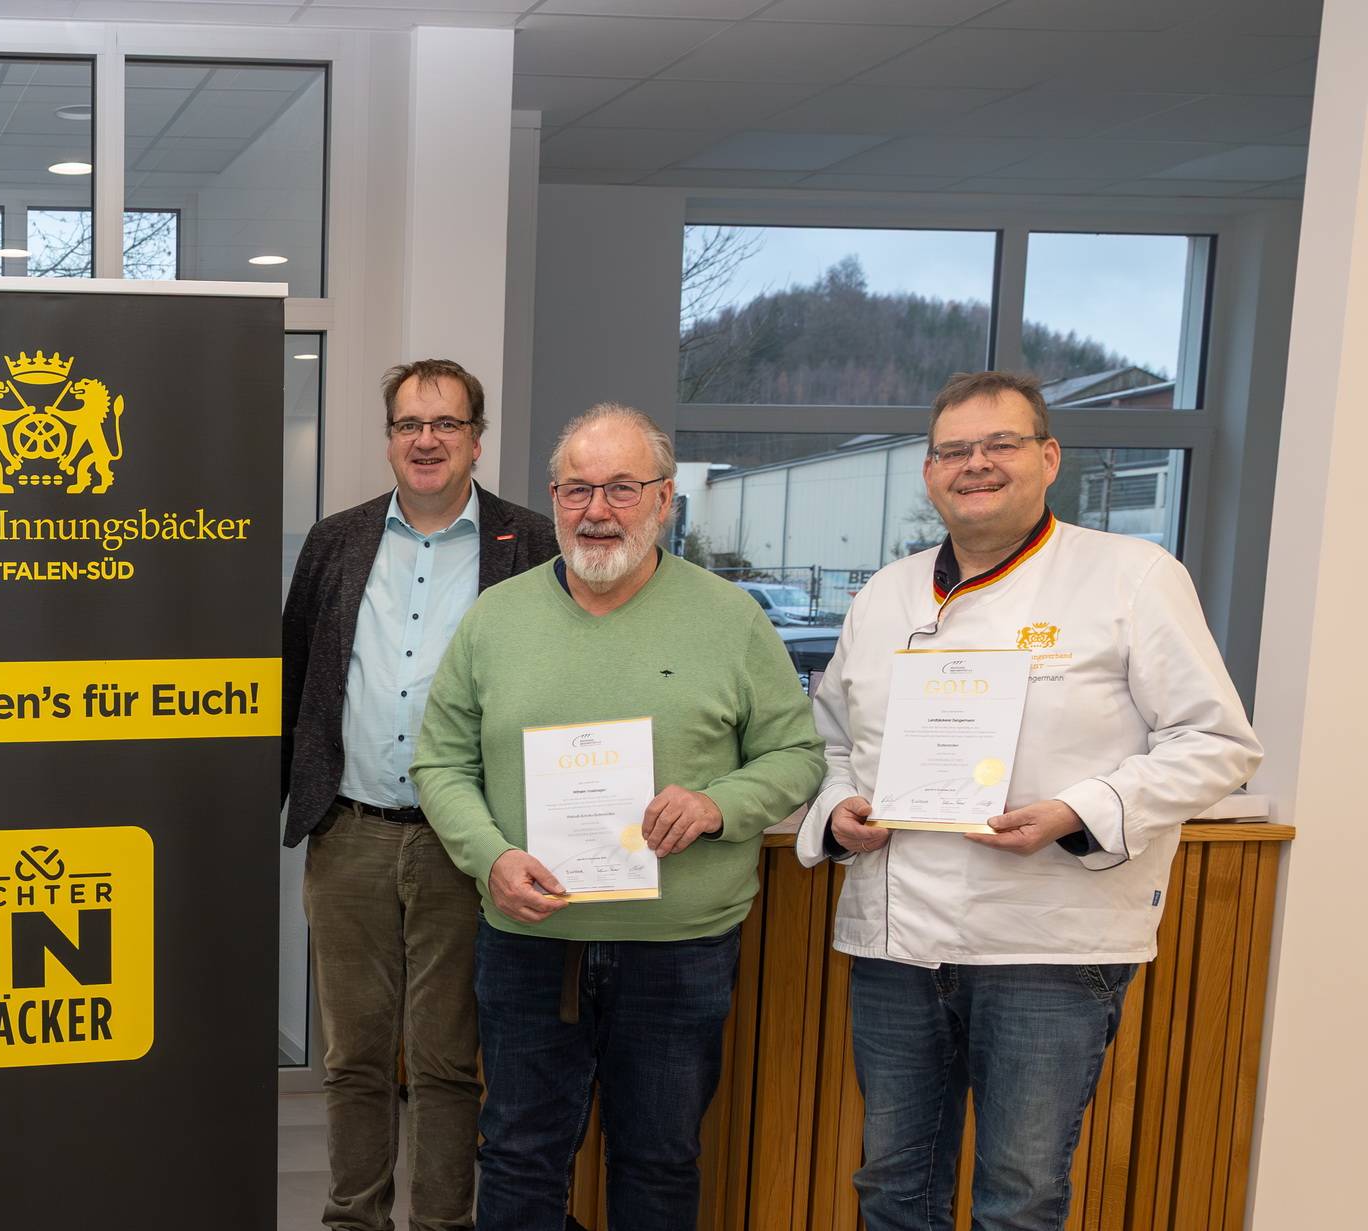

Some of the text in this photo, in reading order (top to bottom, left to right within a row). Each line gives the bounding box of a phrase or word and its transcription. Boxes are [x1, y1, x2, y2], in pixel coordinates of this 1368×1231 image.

[925, 679, 990, 695] GOLD
[82, 683, 139, 718] für
[152, 681, 259, 716] Euch!
[558, 750, 620, 769] GOLD
